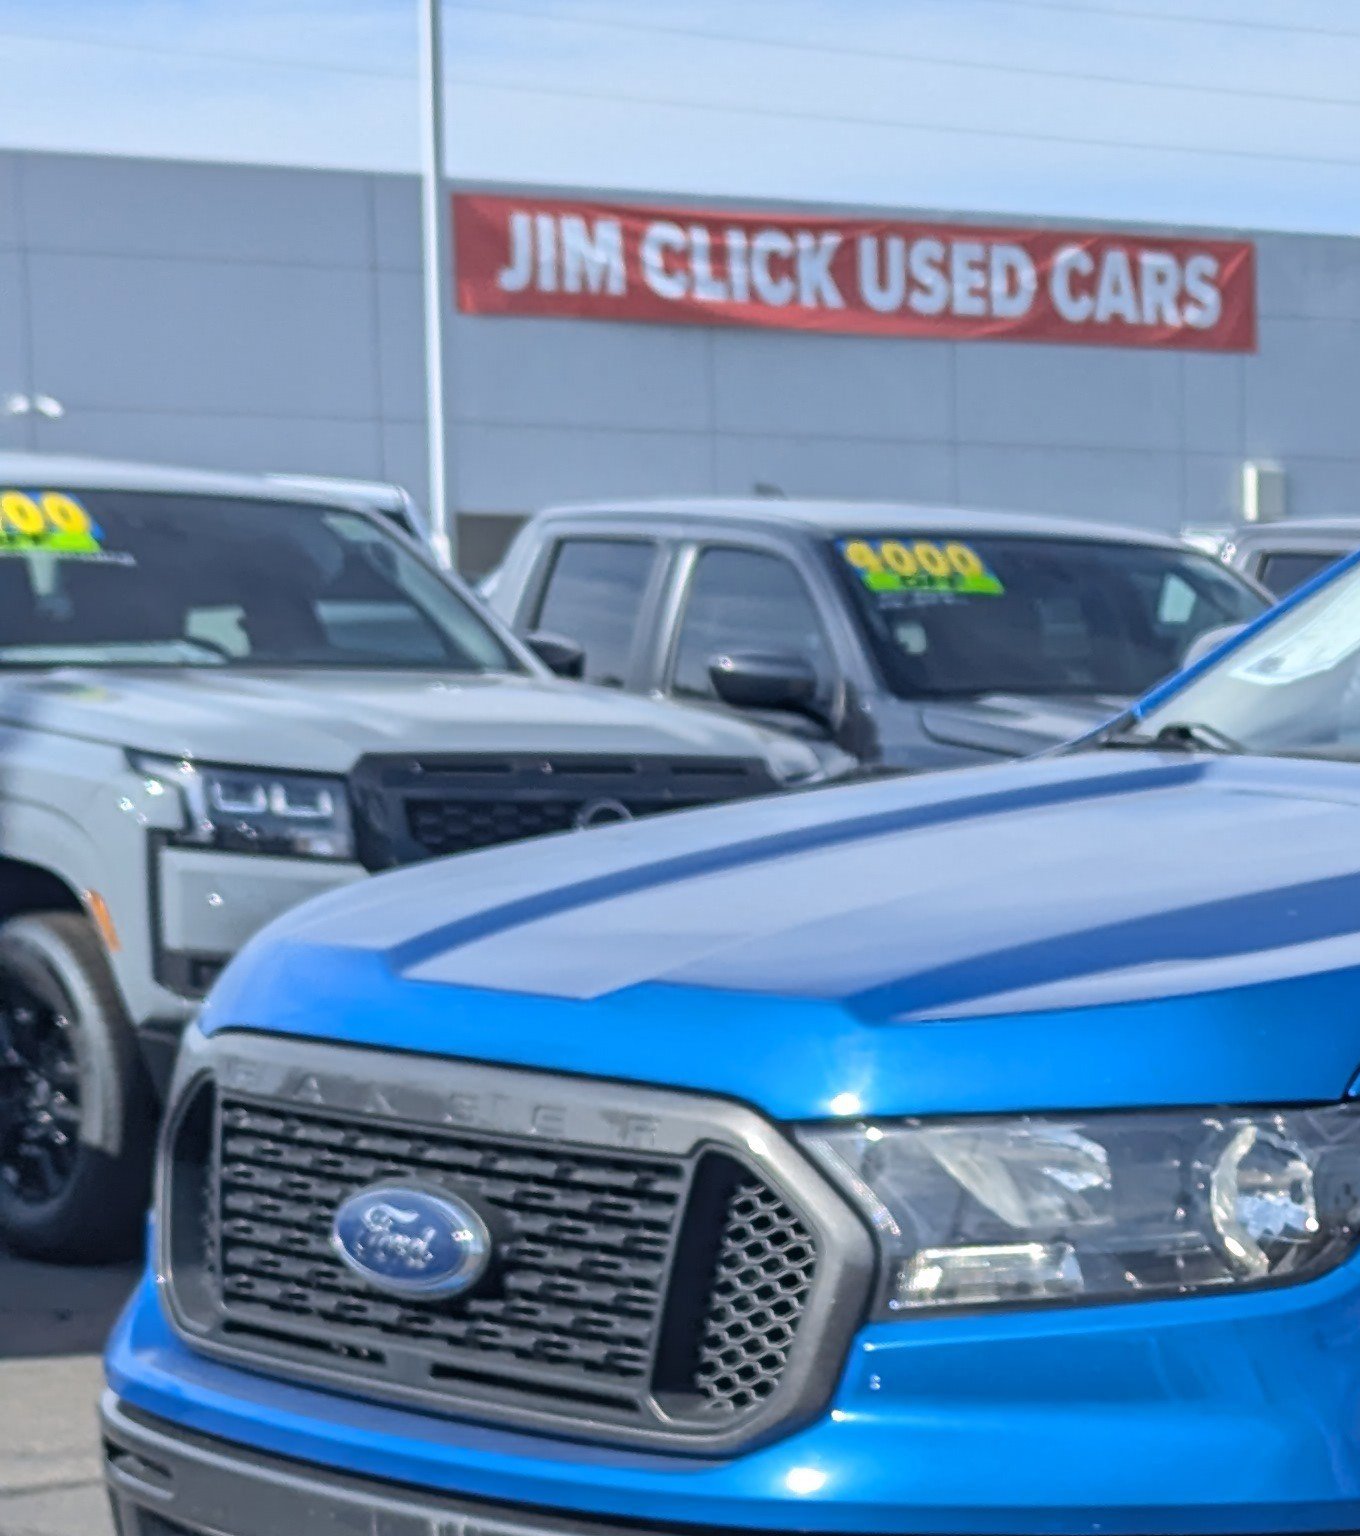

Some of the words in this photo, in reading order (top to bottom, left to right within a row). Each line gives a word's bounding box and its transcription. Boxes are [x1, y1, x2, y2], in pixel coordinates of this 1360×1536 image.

[497, 211, 627, 296] JIM
[640, 220, 846, 309] CLICK
[857, 234, 1038, 319] USED
[1049, 244, 1222, 329] CARS
[356, 1202, 436, 1270] Ford
